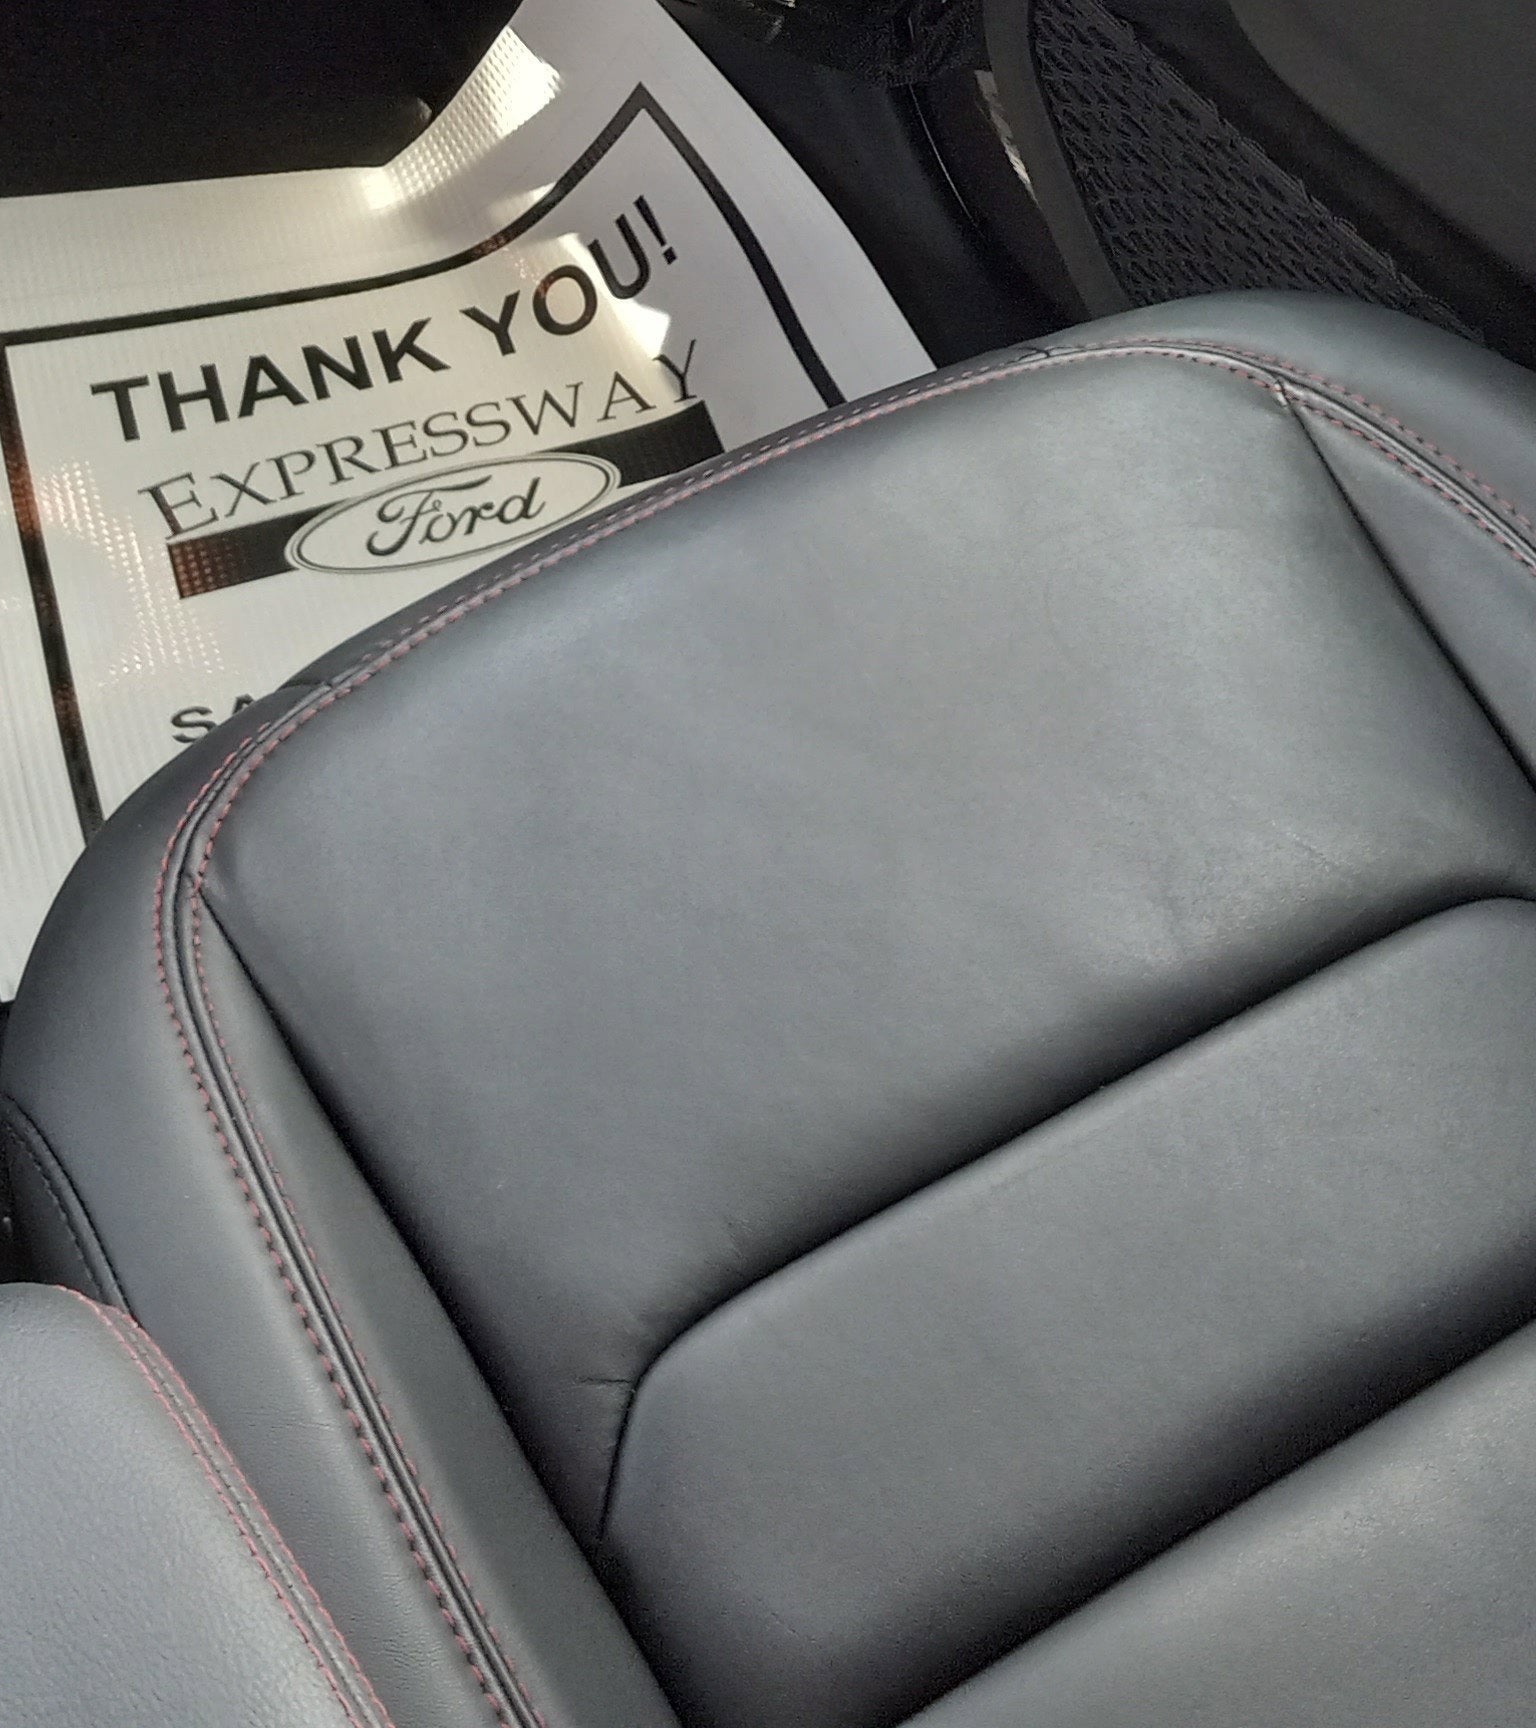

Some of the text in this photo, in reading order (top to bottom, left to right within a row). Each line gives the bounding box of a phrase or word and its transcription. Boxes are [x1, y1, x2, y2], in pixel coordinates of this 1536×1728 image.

[90, 195, 680, 443] THANK YOU!
[137, 338, 703, 542] EXPRESSWAY
[365, 475, 546, 560] Ford
